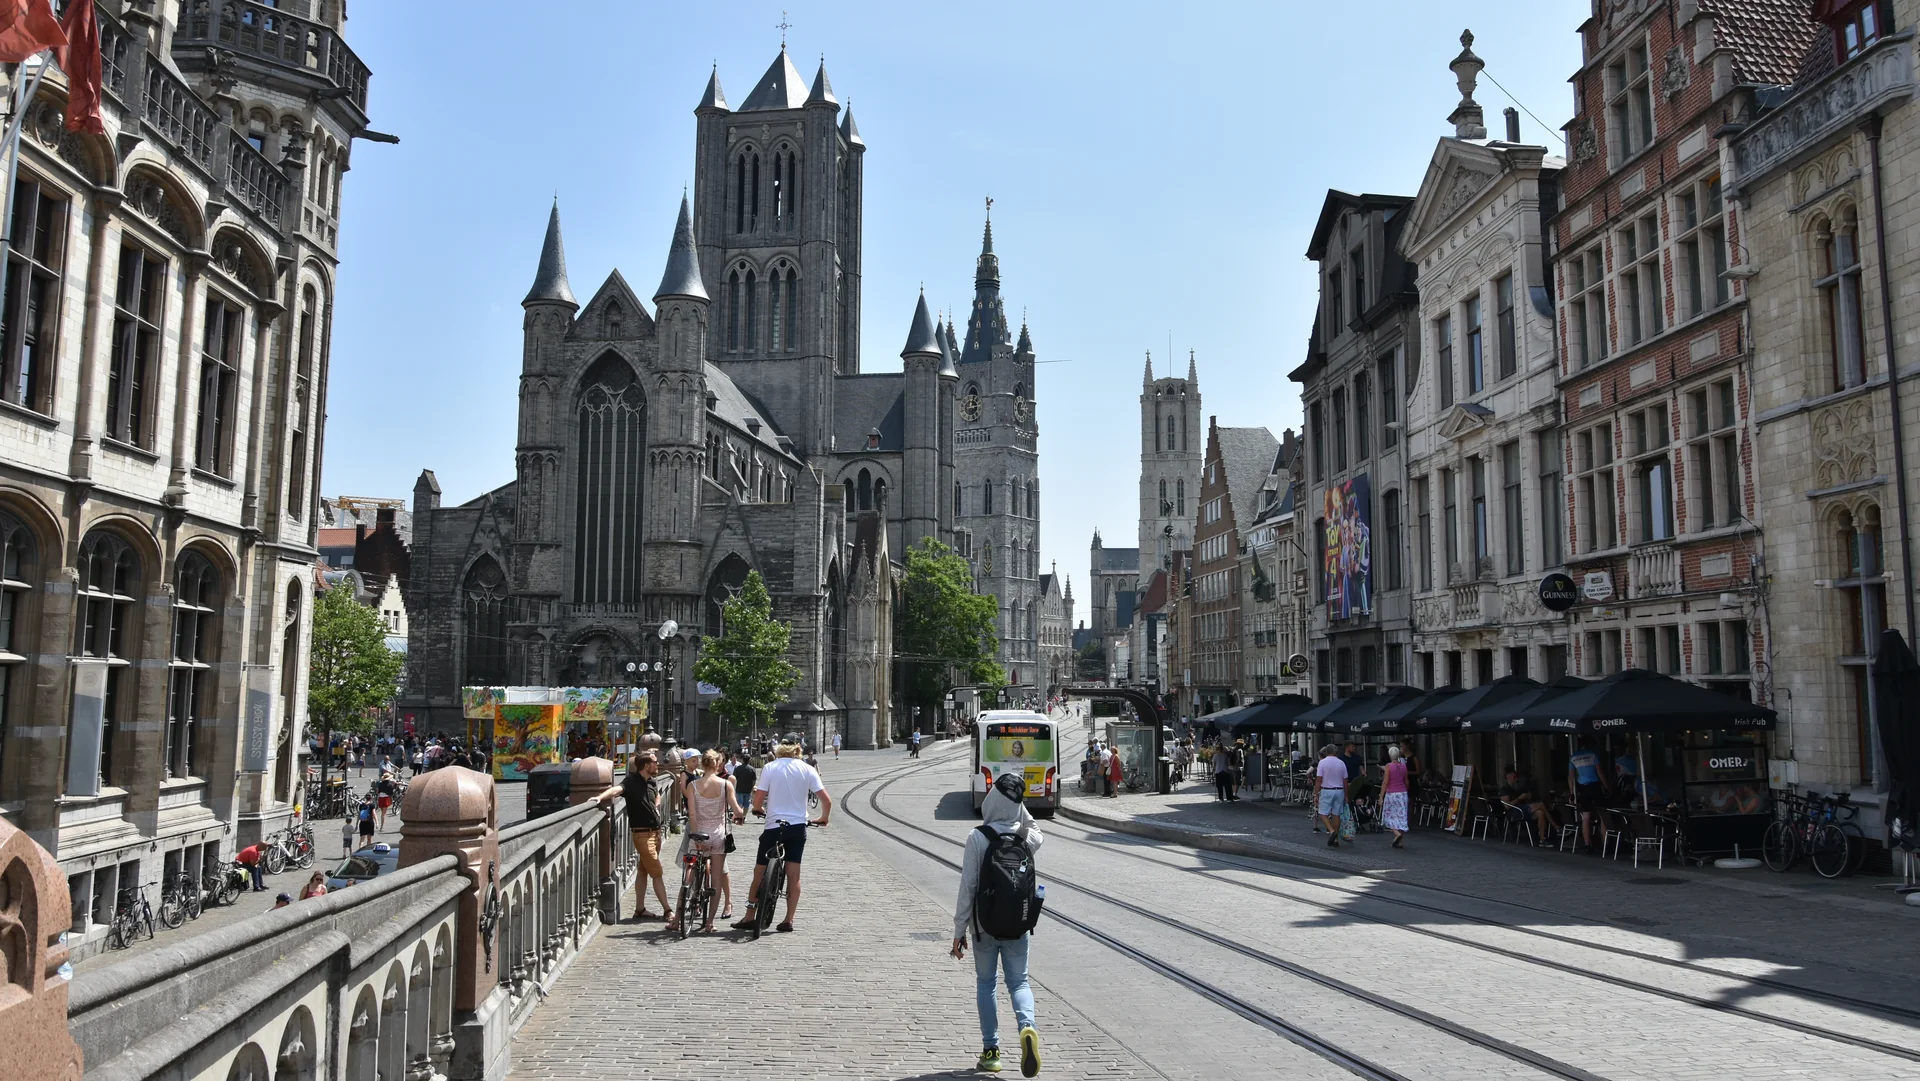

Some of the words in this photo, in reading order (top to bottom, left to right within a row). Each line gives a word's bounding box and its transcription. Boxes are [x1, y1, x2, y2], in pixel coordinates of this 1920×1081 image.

[1326, 524, 1340, 547] TOY
[1330, 558, 1337, 577] 4
[1543, 591, 1575, 599] GUINNESS
[1734, 718, 1750, 726] Irish
[1751, 718, 1766, 726] Pub
